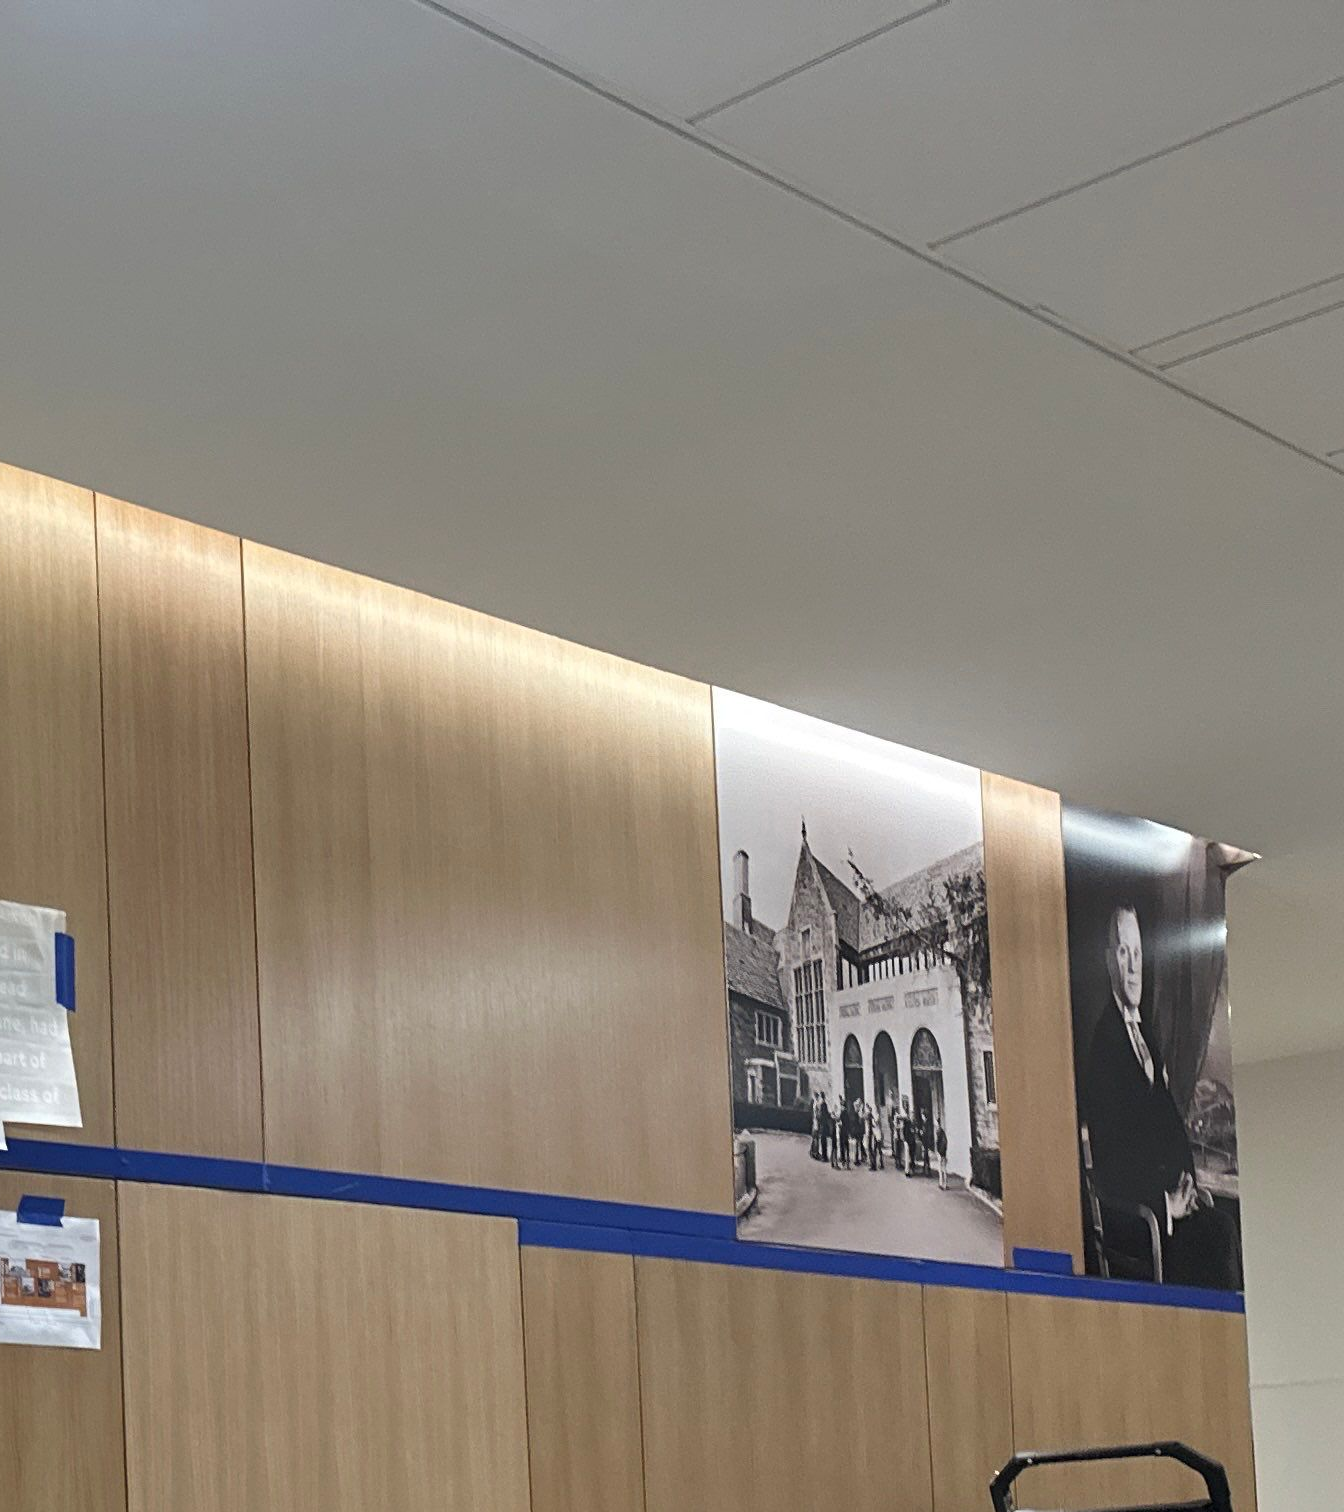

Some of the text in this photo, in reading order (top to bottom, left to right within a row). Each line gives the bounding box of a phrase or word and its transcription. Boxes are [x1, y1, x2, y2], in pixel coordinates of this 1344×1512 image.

[13, 945, 31, 962] in
[30, 1017, 59, 1038] had
[31, 1053, 48, 1070] of
[42, 1087, 62, 1105] of
